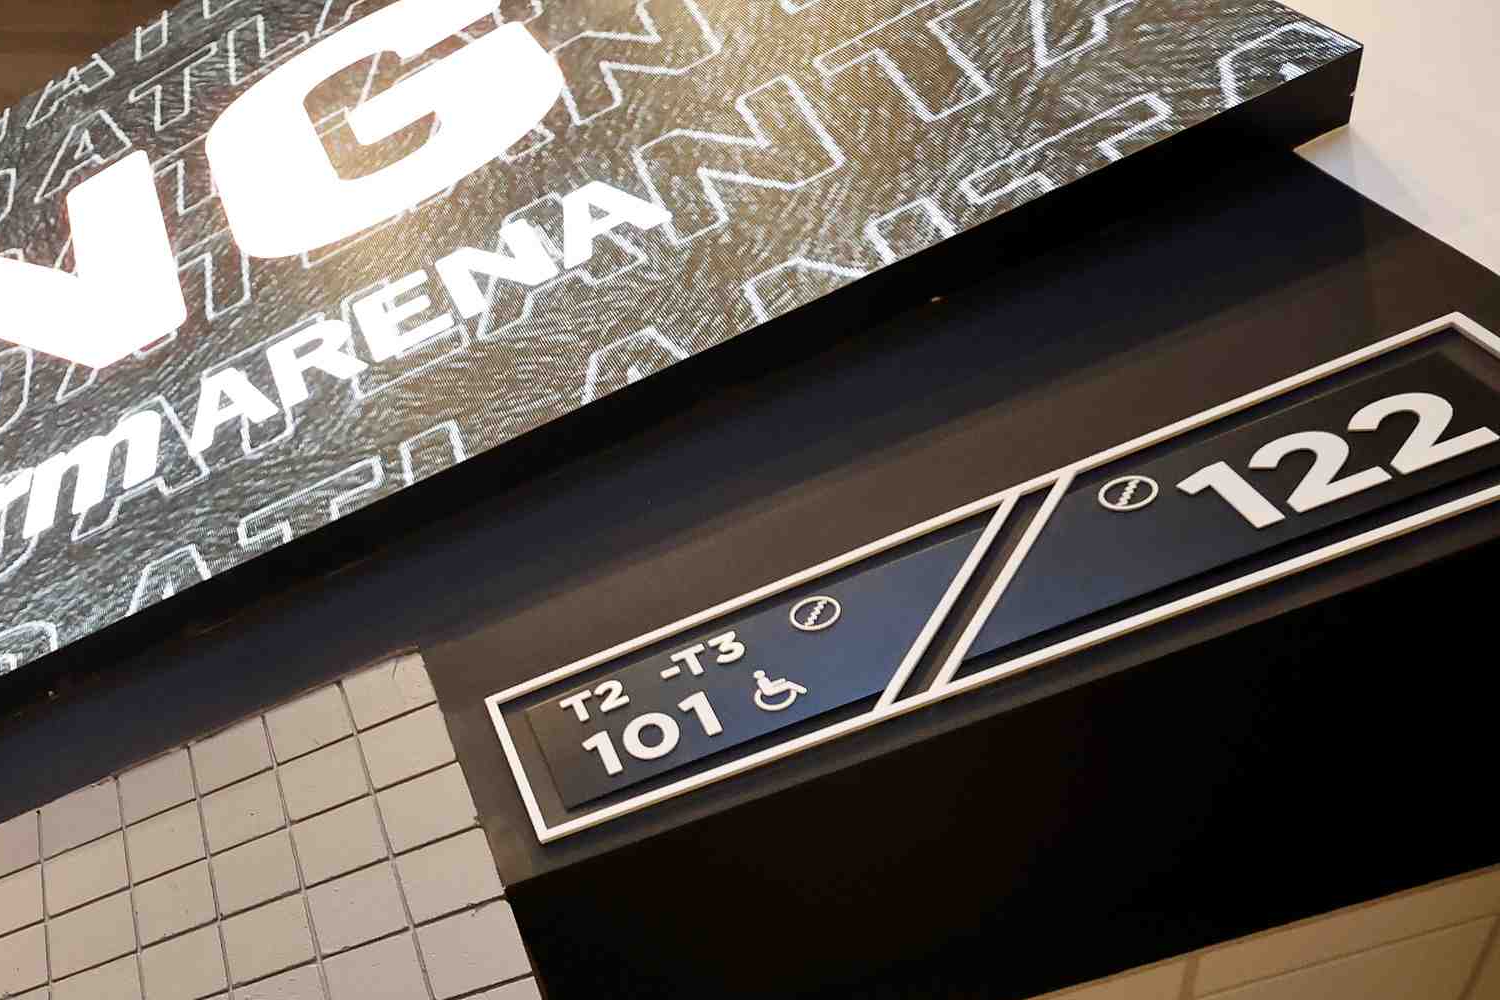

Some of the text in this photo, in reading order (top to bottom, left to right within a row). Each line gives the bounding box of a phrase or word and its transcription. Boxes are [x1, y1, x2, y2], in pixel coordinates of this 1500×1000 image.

[190, 180, 672, 457] ARENA
[1175, 392, 1500, 529] 122
[559, 679, 631, 722] T2
[582, 690, 723, 776] 101
